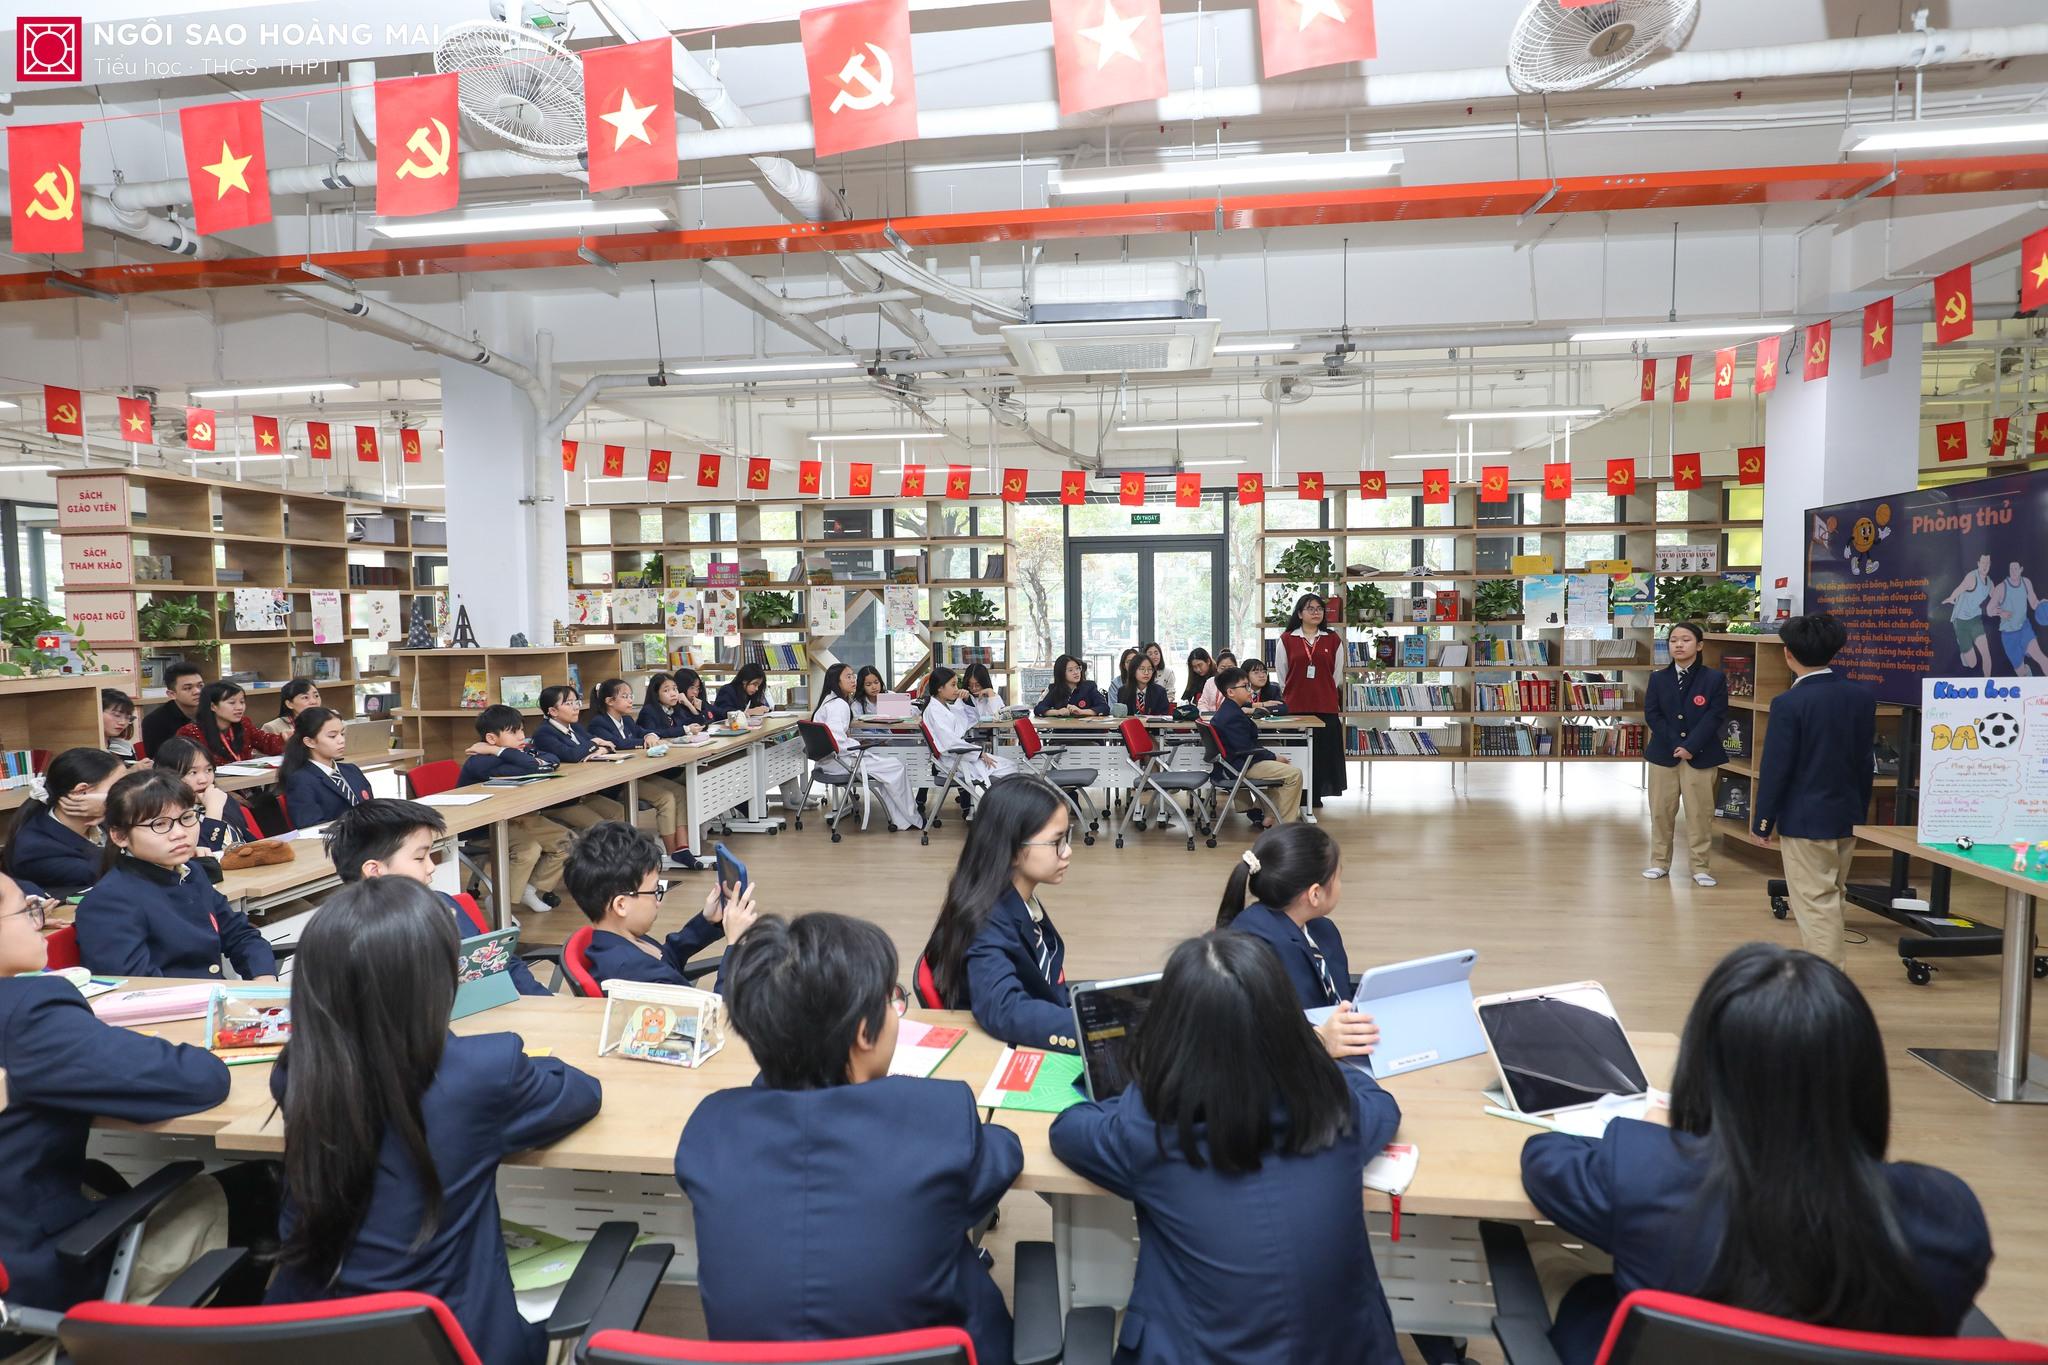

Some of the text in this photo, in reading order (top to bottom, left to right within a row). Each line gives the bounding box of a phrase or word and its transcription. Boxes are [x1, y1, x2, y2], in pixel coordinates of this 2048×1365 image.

[79, 490, 103, 500] SÁCH
[67, 502, 117, 513] GIÁO VIÊN
[1912, 499, 2013, 535] Phòng thủ
[83, 547, 107, 557] SÁCH
[69, 562, 95, 570] THAM
[73, 612, 103, 623] NGOẠI
[1934, 681, 1978, 699] Khoa
